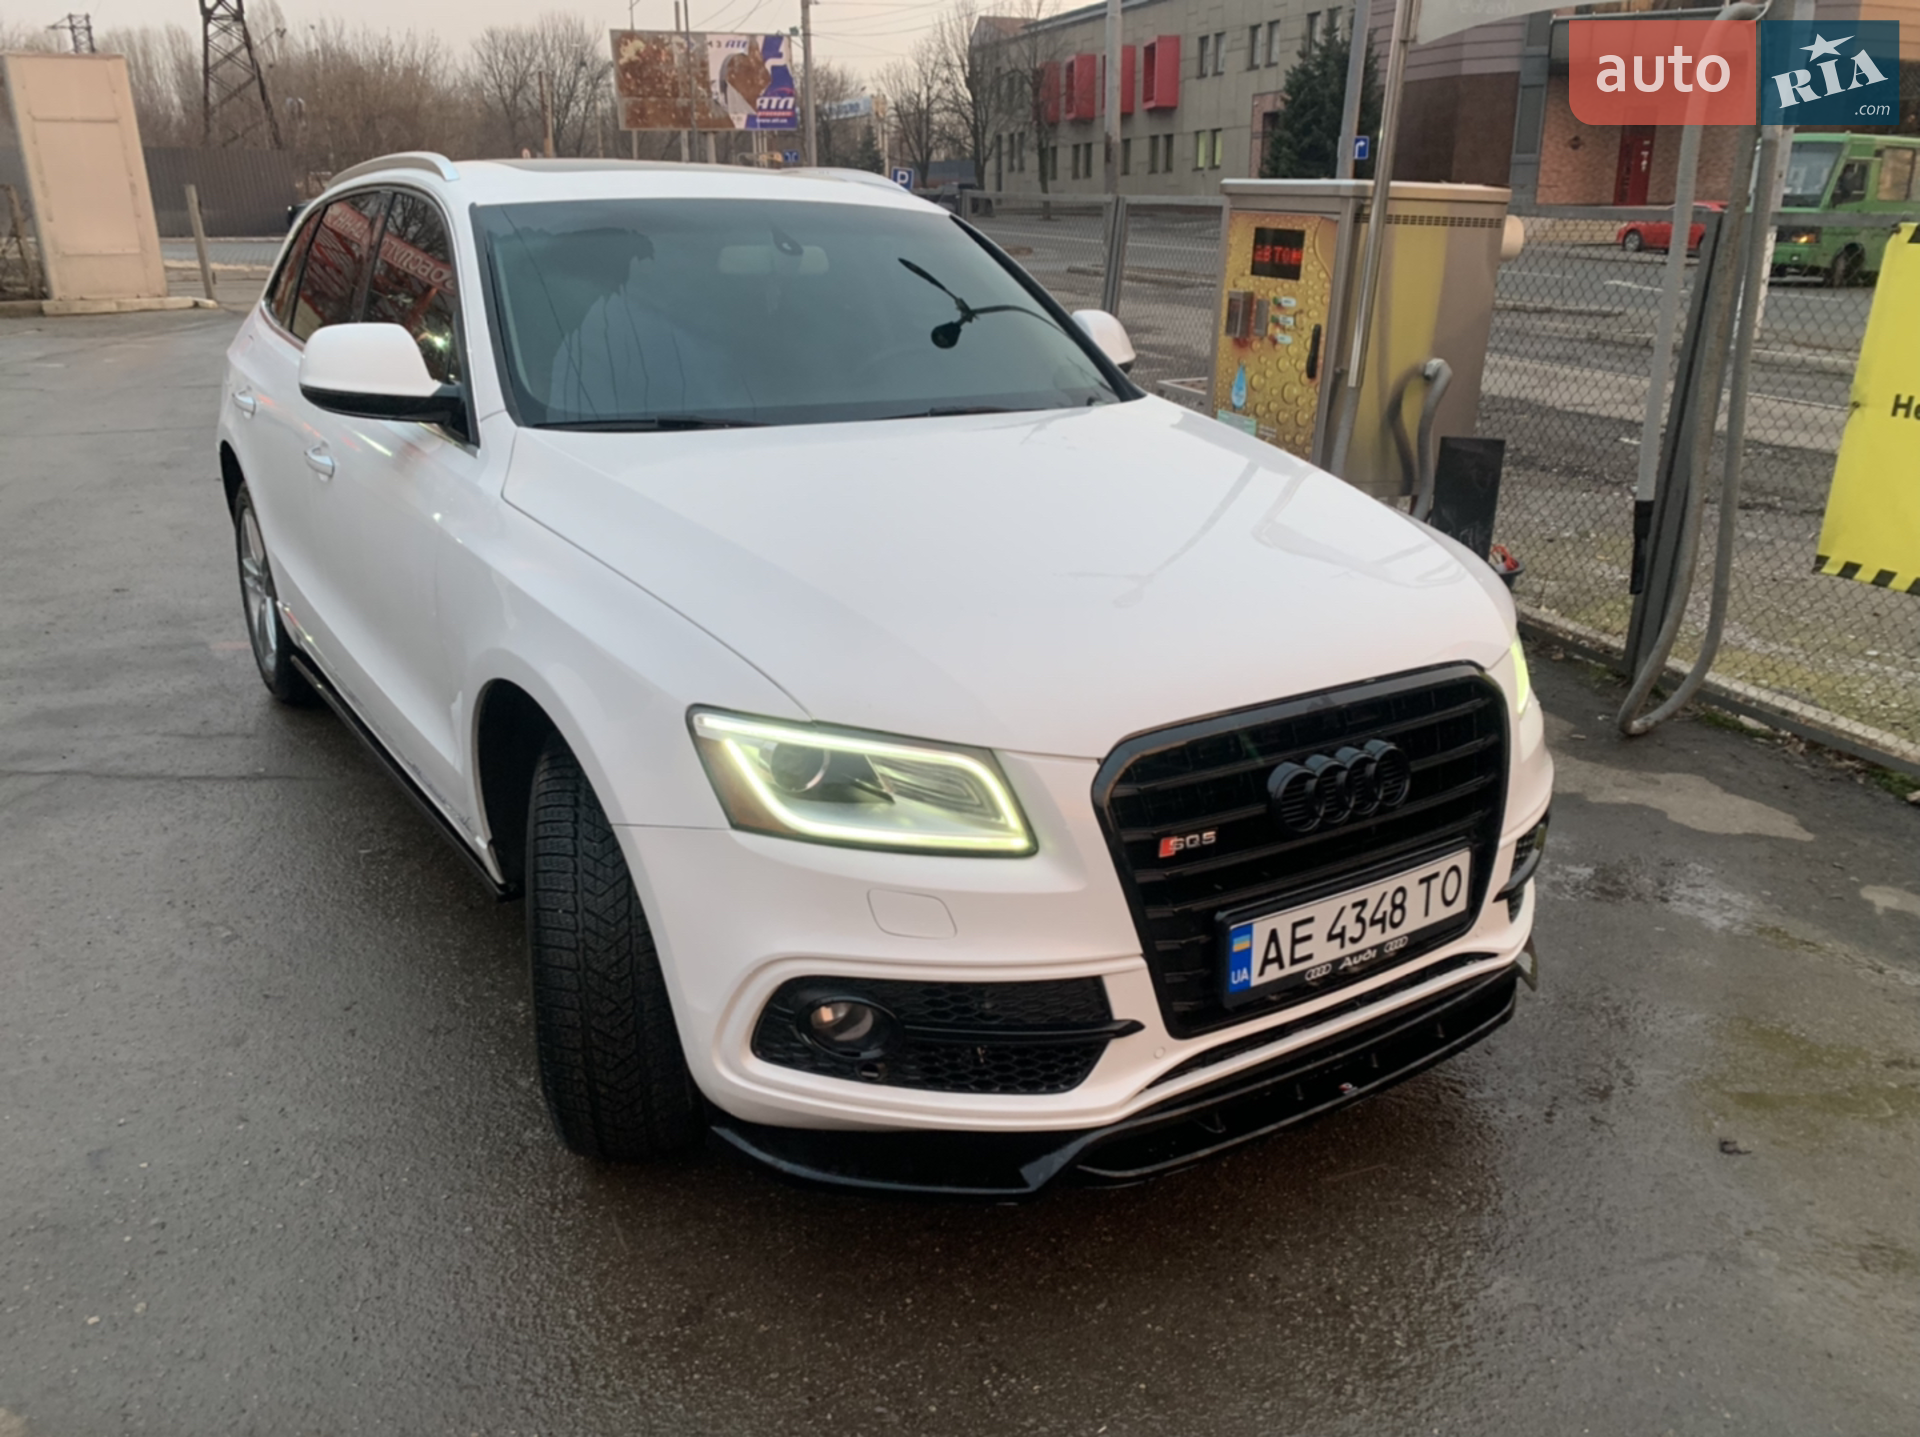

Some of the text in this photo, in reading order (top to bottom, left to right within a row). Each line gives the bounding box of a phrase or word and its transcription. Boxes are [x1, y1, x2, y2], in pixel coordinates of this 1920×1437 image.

[896, 170, 910, 184] P
[1168, 830, 1217, 851] SQ5
[1258, 864, 1462, 977] AE 4348 TO
[1339, 949, 1378, 970] Audi
[1231, 967, 1250, 985] UA
